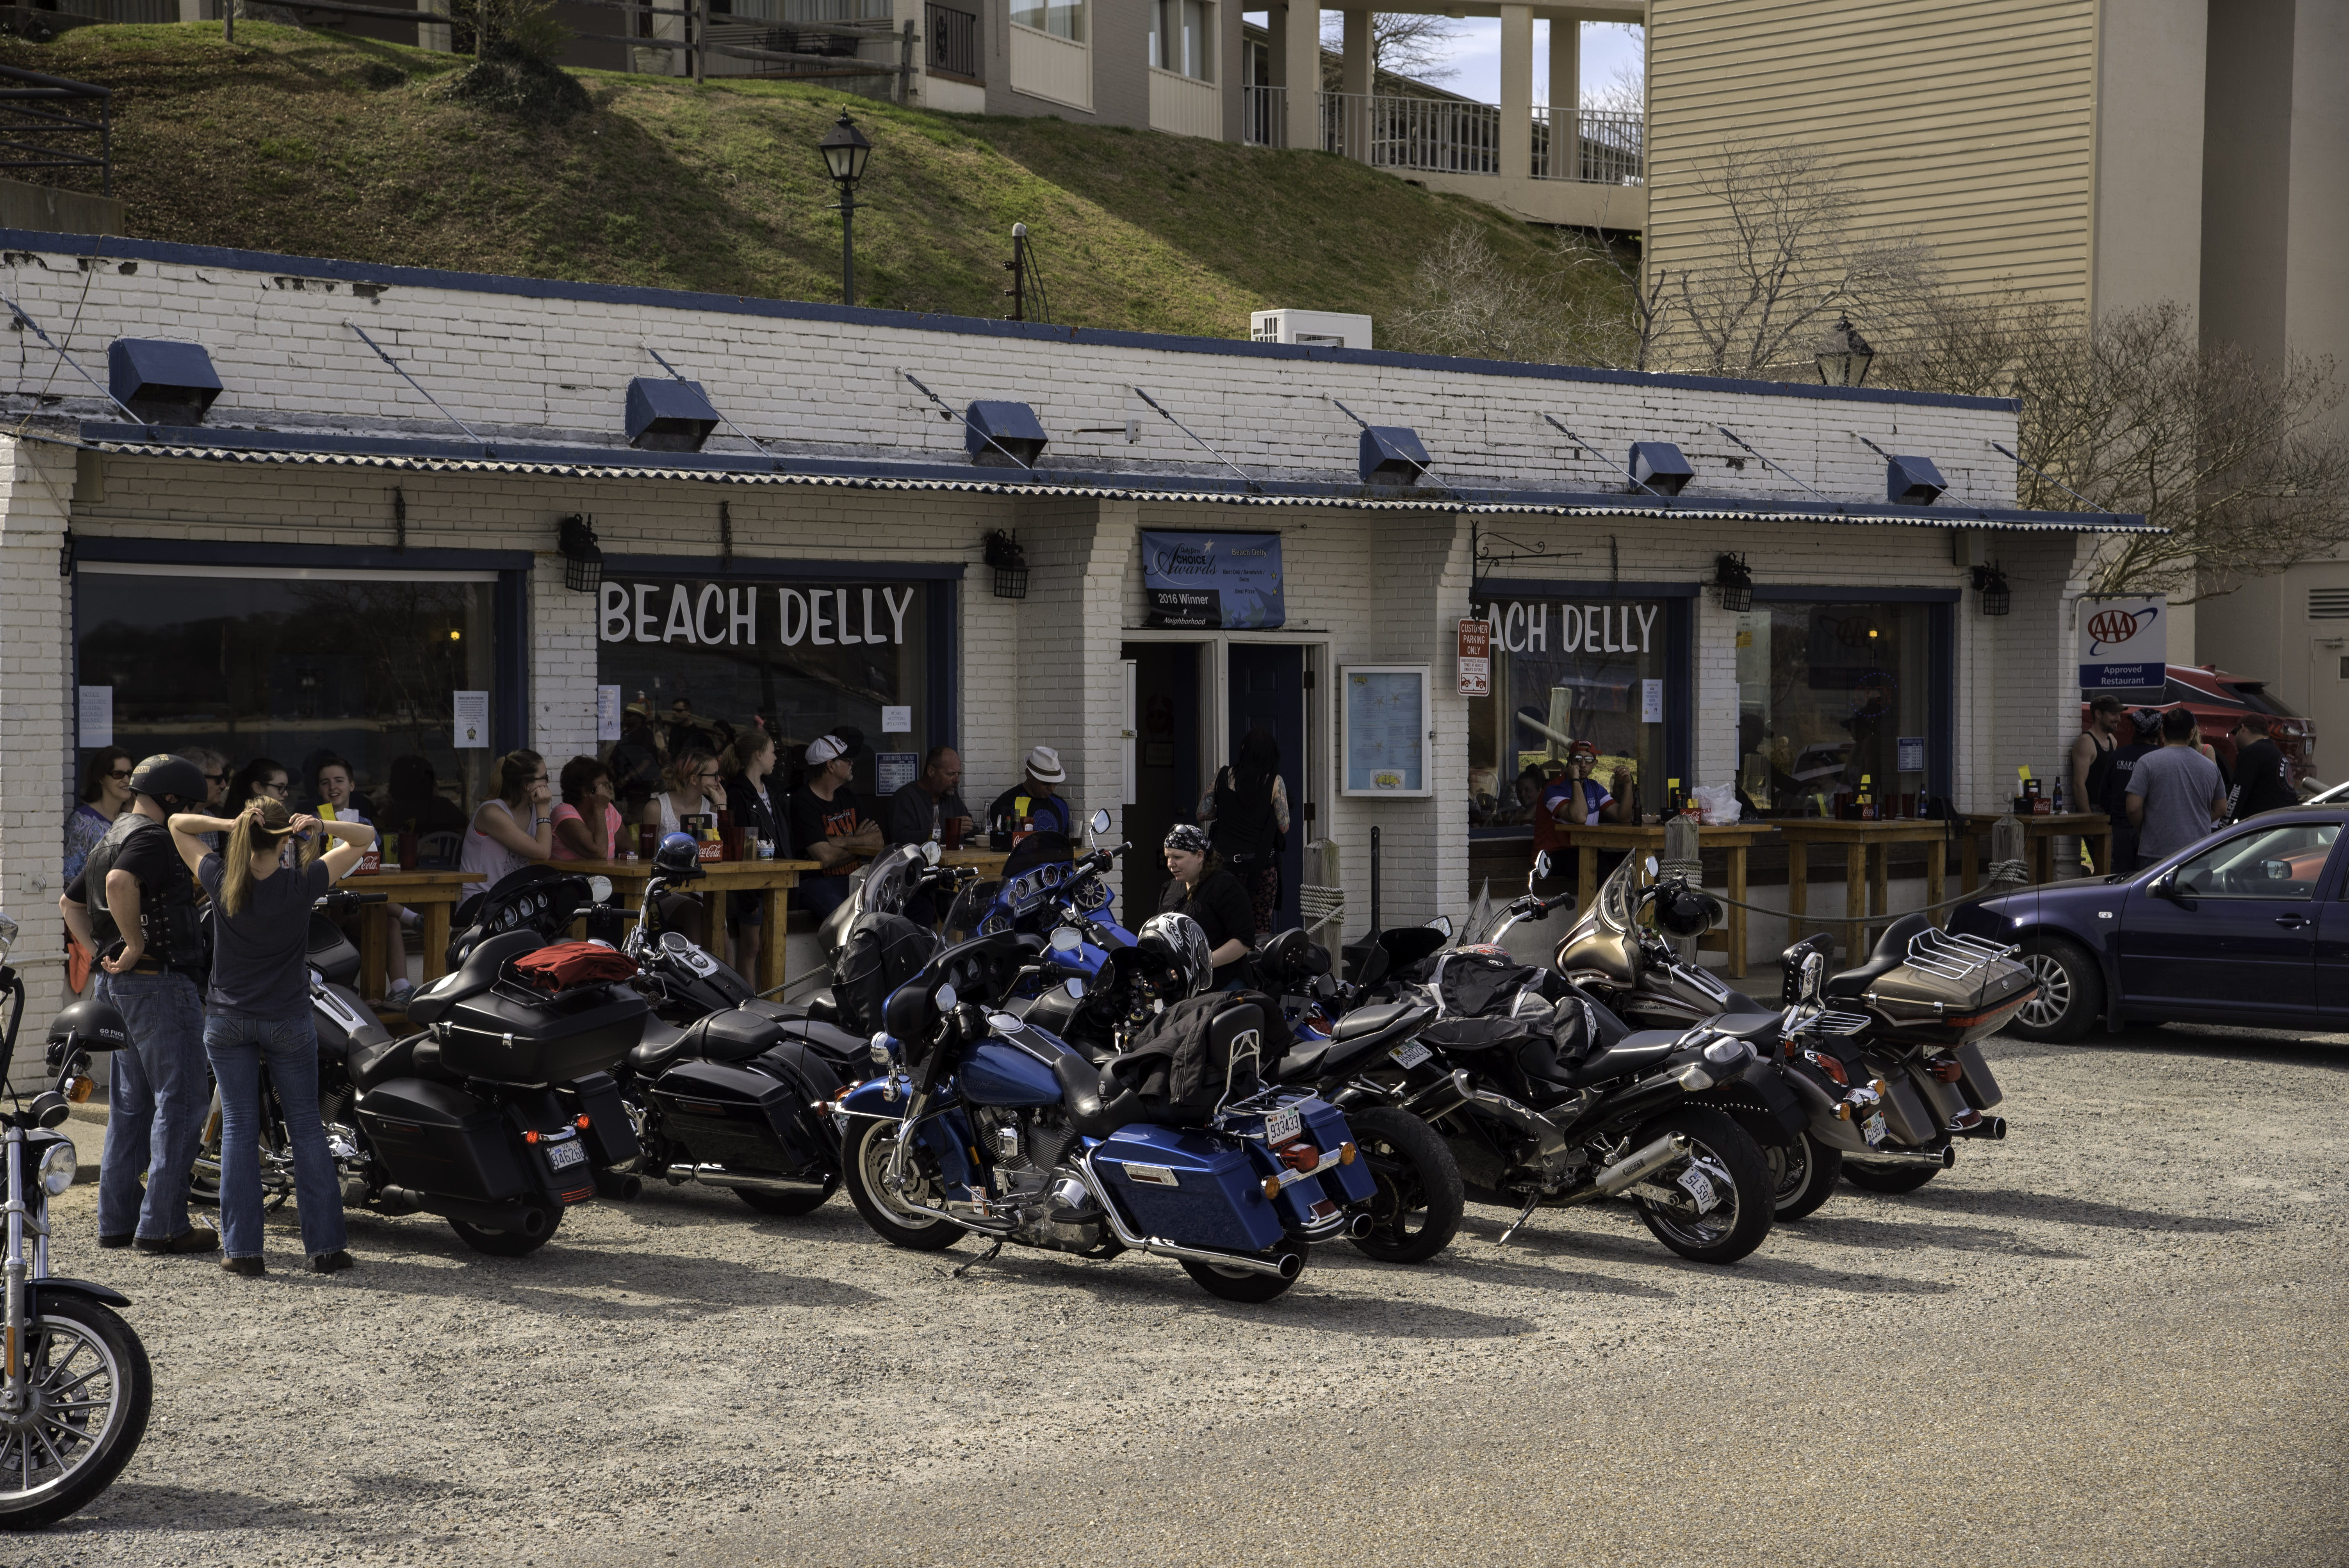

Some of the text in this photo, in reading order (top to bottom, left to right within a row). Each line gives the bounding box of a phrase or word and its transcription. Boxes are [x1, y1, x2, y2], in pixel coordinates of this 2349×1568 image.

[1144, 543, 1218, 576] Awards
[1252, 549, 1267, 558] Delly
[1176, 555, 1206, 565] CHOICE
[1158, 594, 1208, 604] 2016 Winner
[600, 581, 914, 646] BEACH DELLY
[1163, 617, 1206, 625] Neighborhood
[2093, 610, 2132, 642] AAA
[1461, 624, 1488, 634] CUSTOMER
[1469, 602, 1658, 653] ACH DELLY
[1463, 635, 1485, 644] PARKING
[1467, 646, 1480, 655] ONLY
[2104, 665, 2142, 675] Approved
[2226, 783, 2241, 818] ELECTRIC
[1171, 925, 1182, 943] HJC
[110, 1030, 124, 1038] FUCK
[1397, 1044, 1426, 1064] 866028
[1271, 1115, 1299, 1138] 933433
[1624, 1159, 1641, 1174] MUZZY
